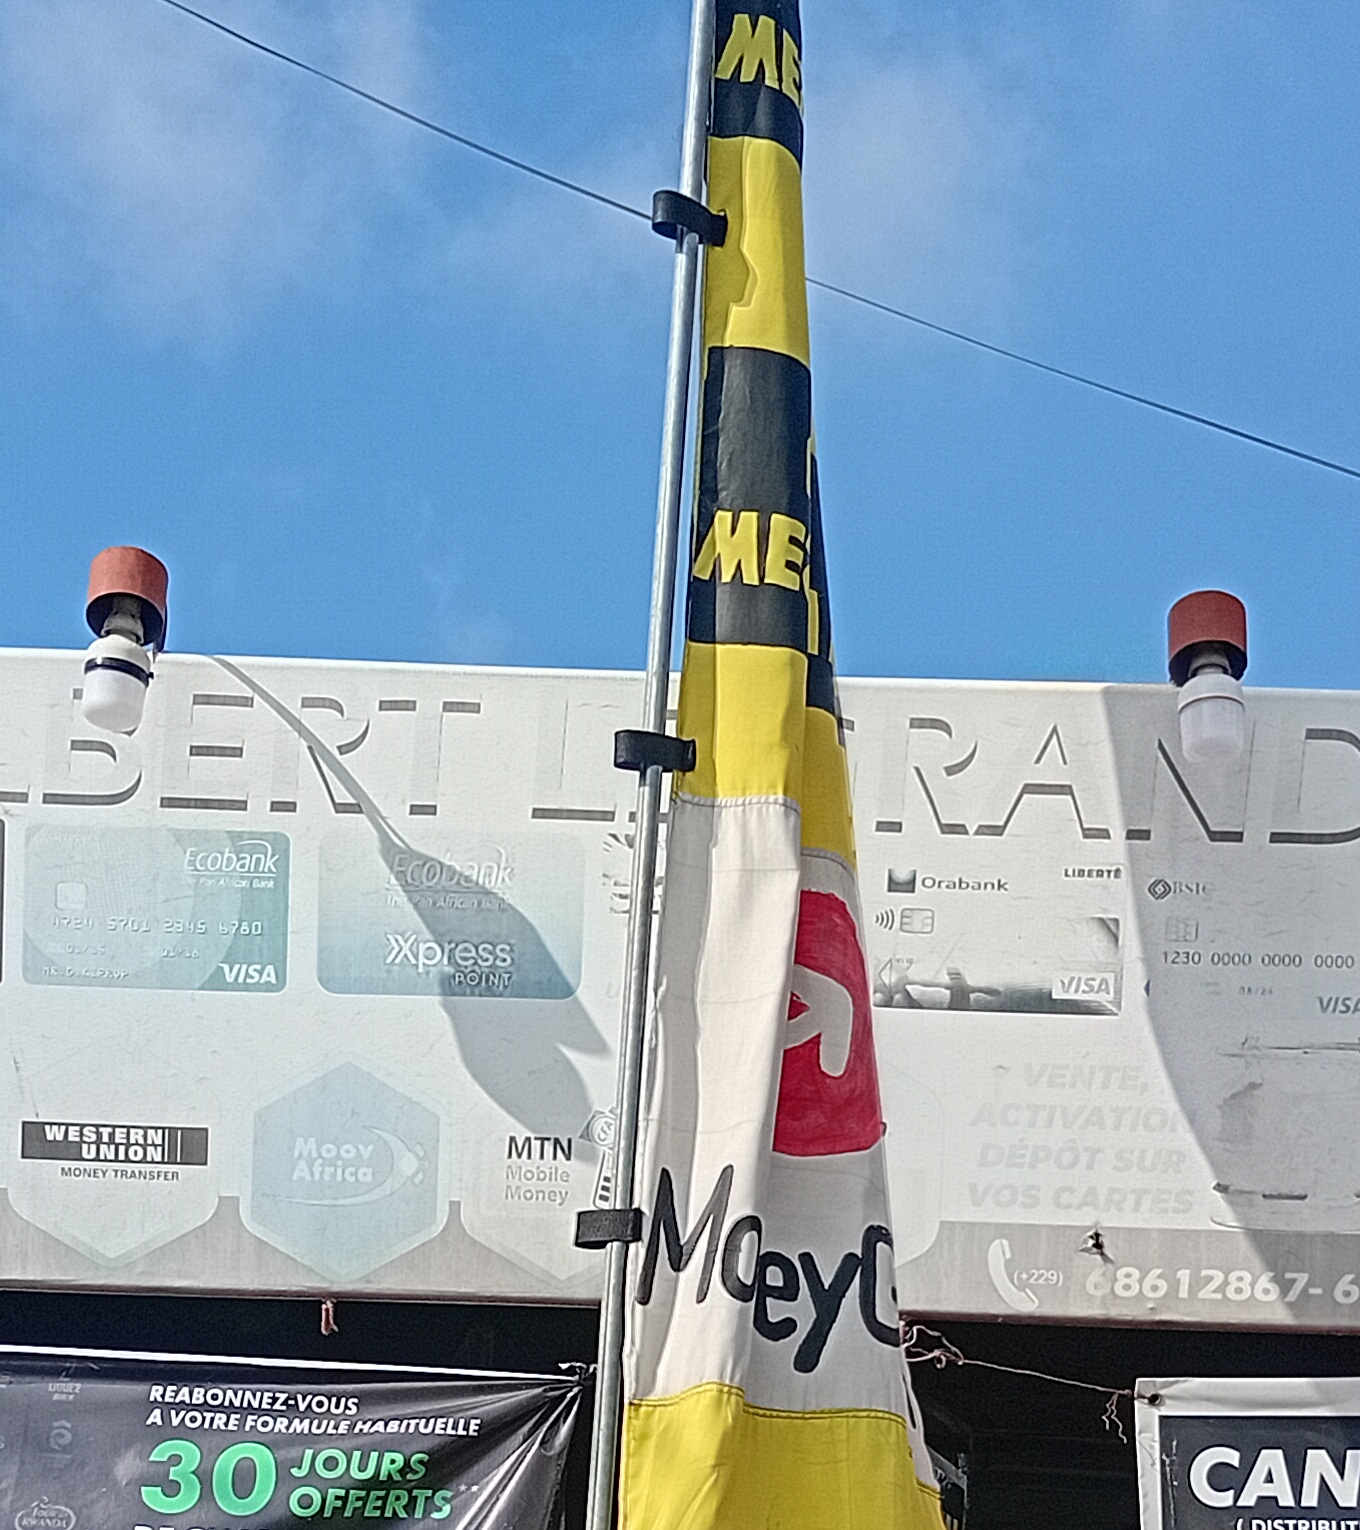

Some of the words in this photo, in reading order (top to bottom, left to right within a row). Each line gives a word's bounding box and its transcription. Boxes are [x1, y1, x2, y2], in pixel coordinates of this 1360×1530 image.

[185, 841, 280, 873] Ecobank
[920, 874, 1009, 892] Orabank
[217, 962, 277, 985] VISA
[1059, 976, 1112, 996] VISA
[44, 1124, 163, 1145] WESTERN
[81, 1142, 163, 1162] UNION
[292, 1136, 375, 1160] Moov
[507, 1135, 572, 1162] MTN
[976, 1137, 1107, 1171] DÉPÔT
[1112, 1145, 1188, 1175] SUR
[60, 1166, 108, 1180] MONEY
[112, 1168, 180, 1182] TRANSFER
[291, 1158, 375, 1183] Africa
[505, 1164, 571, 1184] Mobile
[505, 1185, 570, 1207] Money
[967, 1182, 1041, 1210] VOS
[1051, 1186, 1196, 1215] CARTES
[1013, 1268, 1064, 1288] (+229)
[169, 1410, 241, 1432] VOTRE
[244, 1414, 350, 1436] FORMULE
[353, 1417, 482, 1438] HABITUELLE
[140, 1438, 278, 1517] 30
[289, 1448, 430, 1482] JOURS
